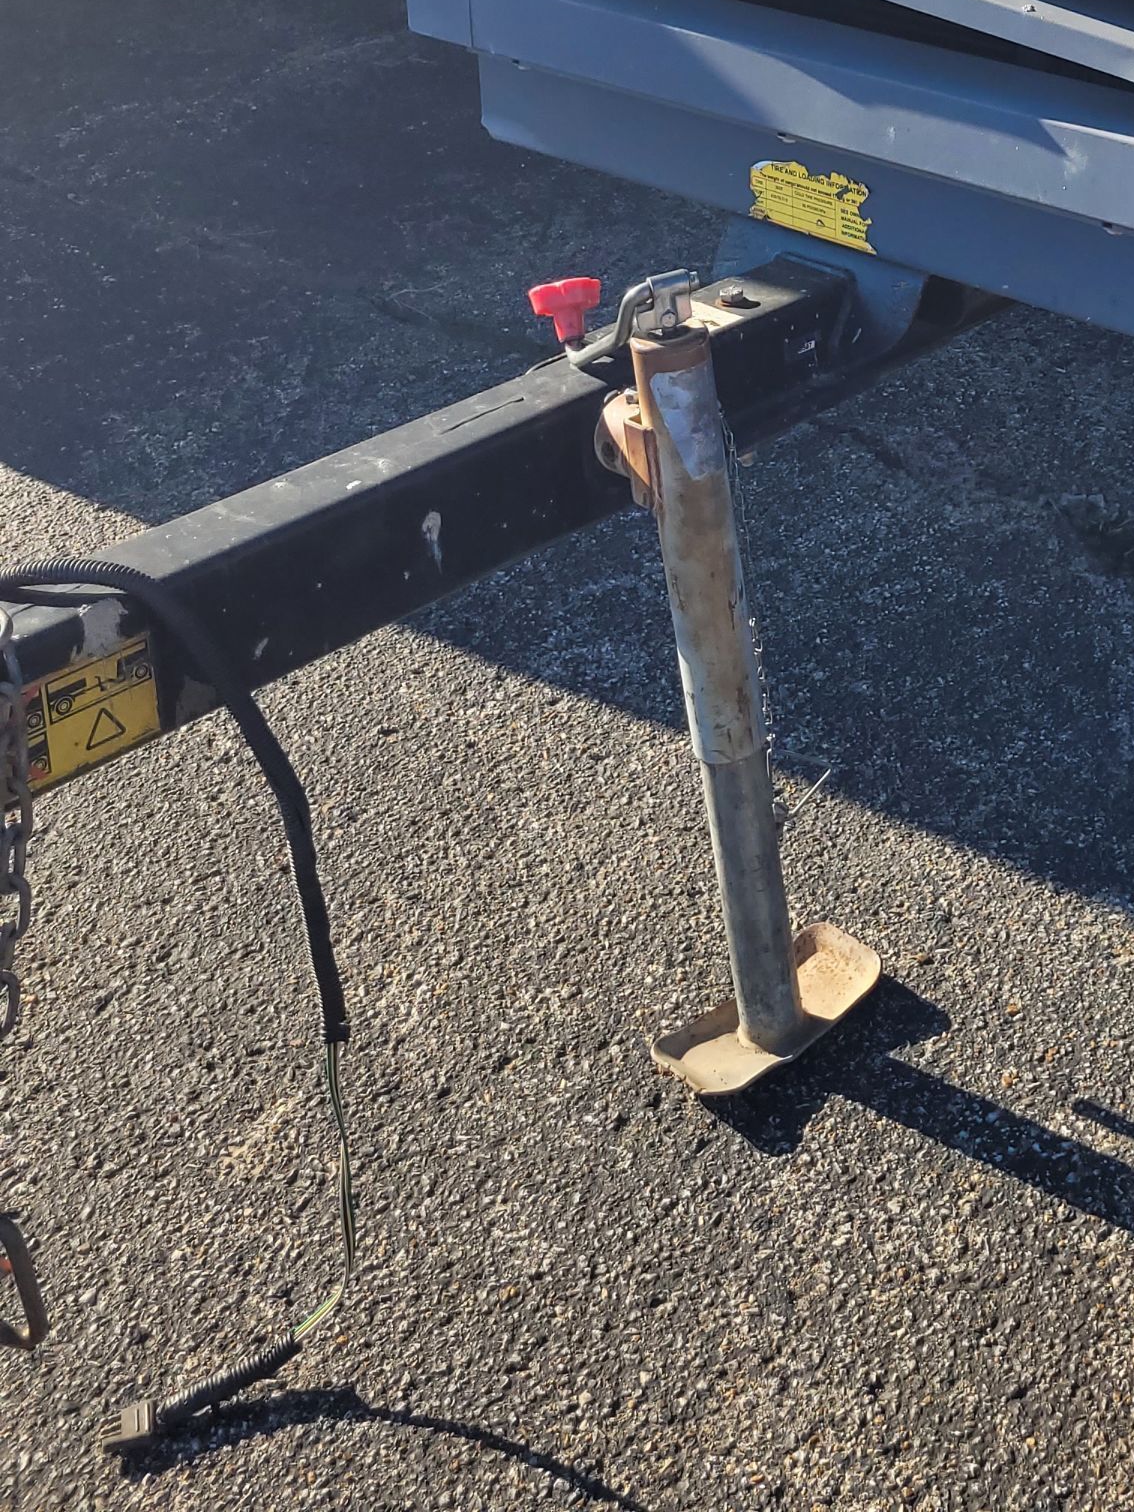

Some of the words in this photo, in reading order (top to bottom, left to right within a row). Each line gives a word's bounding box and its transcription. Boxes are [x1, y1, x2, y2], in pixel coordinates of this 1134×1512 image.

[771, 162, 784, 174] TIRE
[785, 168, 797, 177] AND
[826, 180, 867, 197] INFORATION
